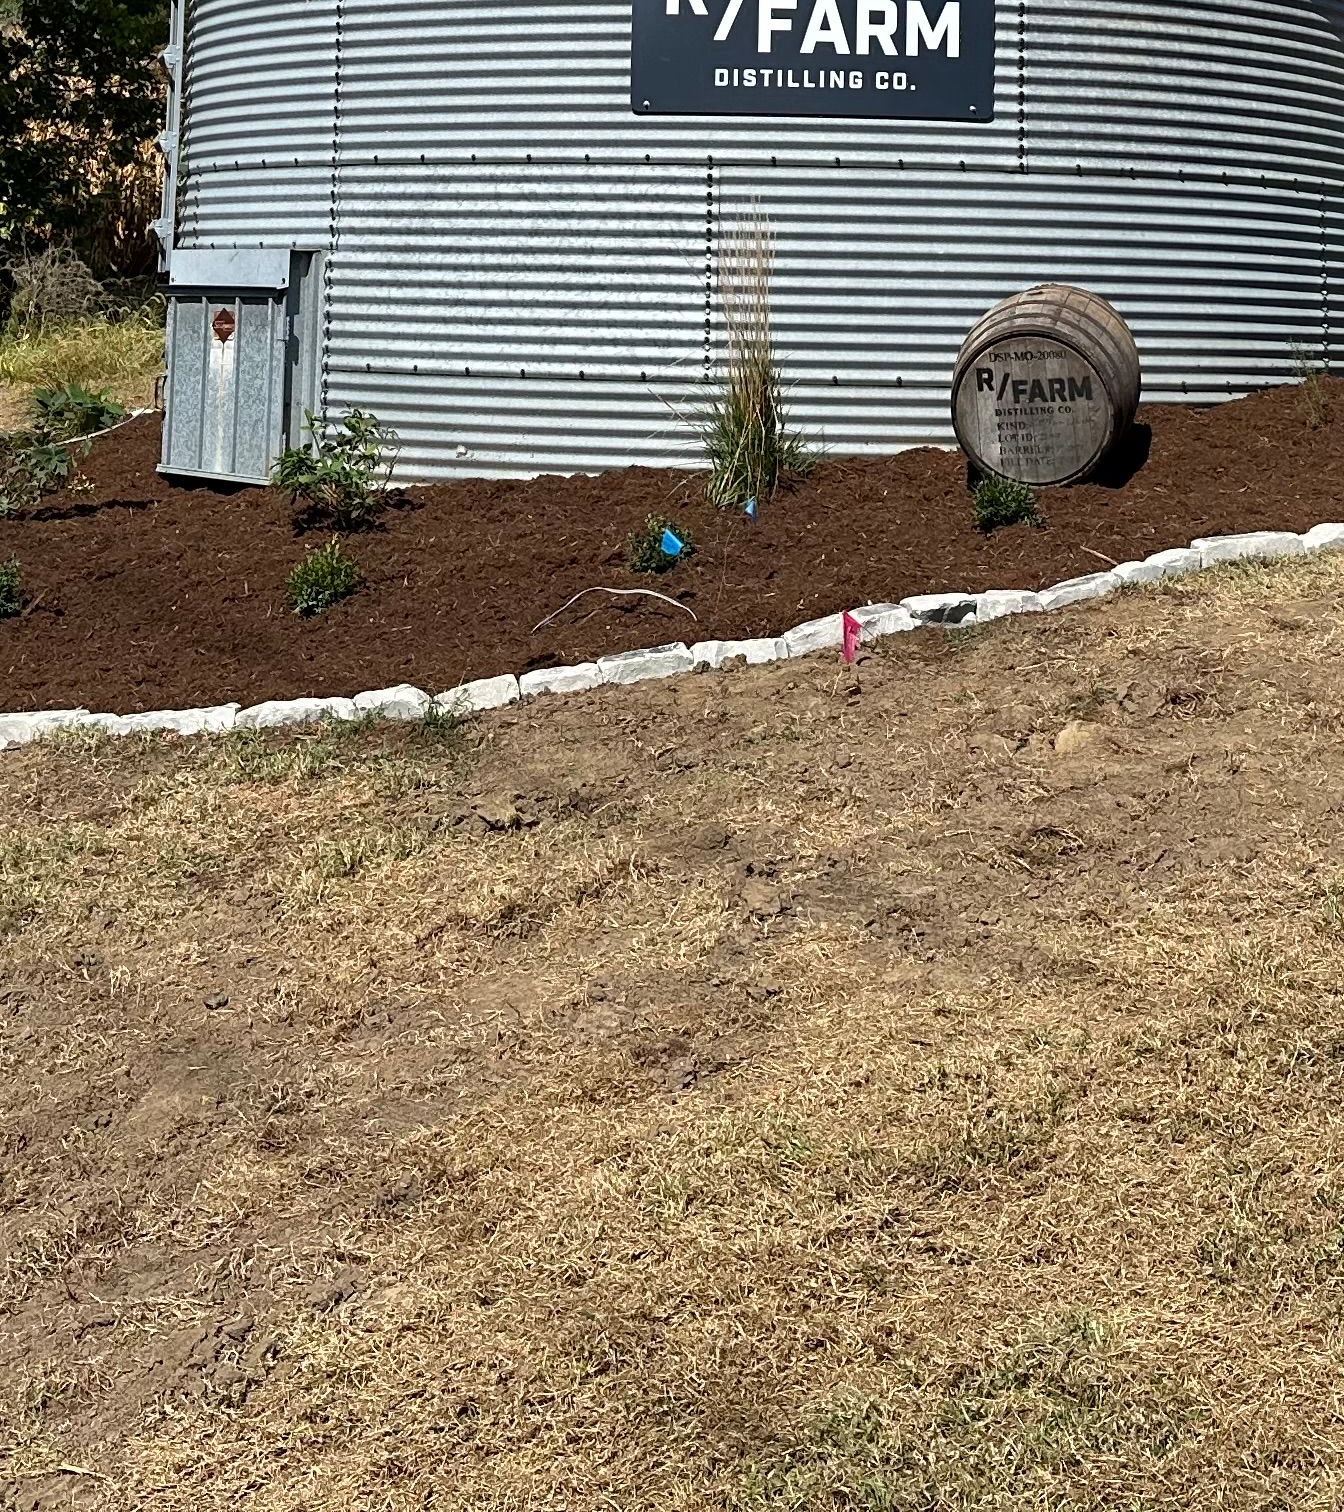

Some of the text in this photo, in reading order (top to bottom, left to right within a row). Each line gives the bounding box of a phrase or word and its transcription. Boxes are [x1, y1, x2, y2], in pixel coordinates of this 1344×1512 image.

[714, 68, 917, 91] DISTILLING CO.
[976, 368, 1093, 404] R/FARM
[995, 406, 1054, 417] DISTILLING
